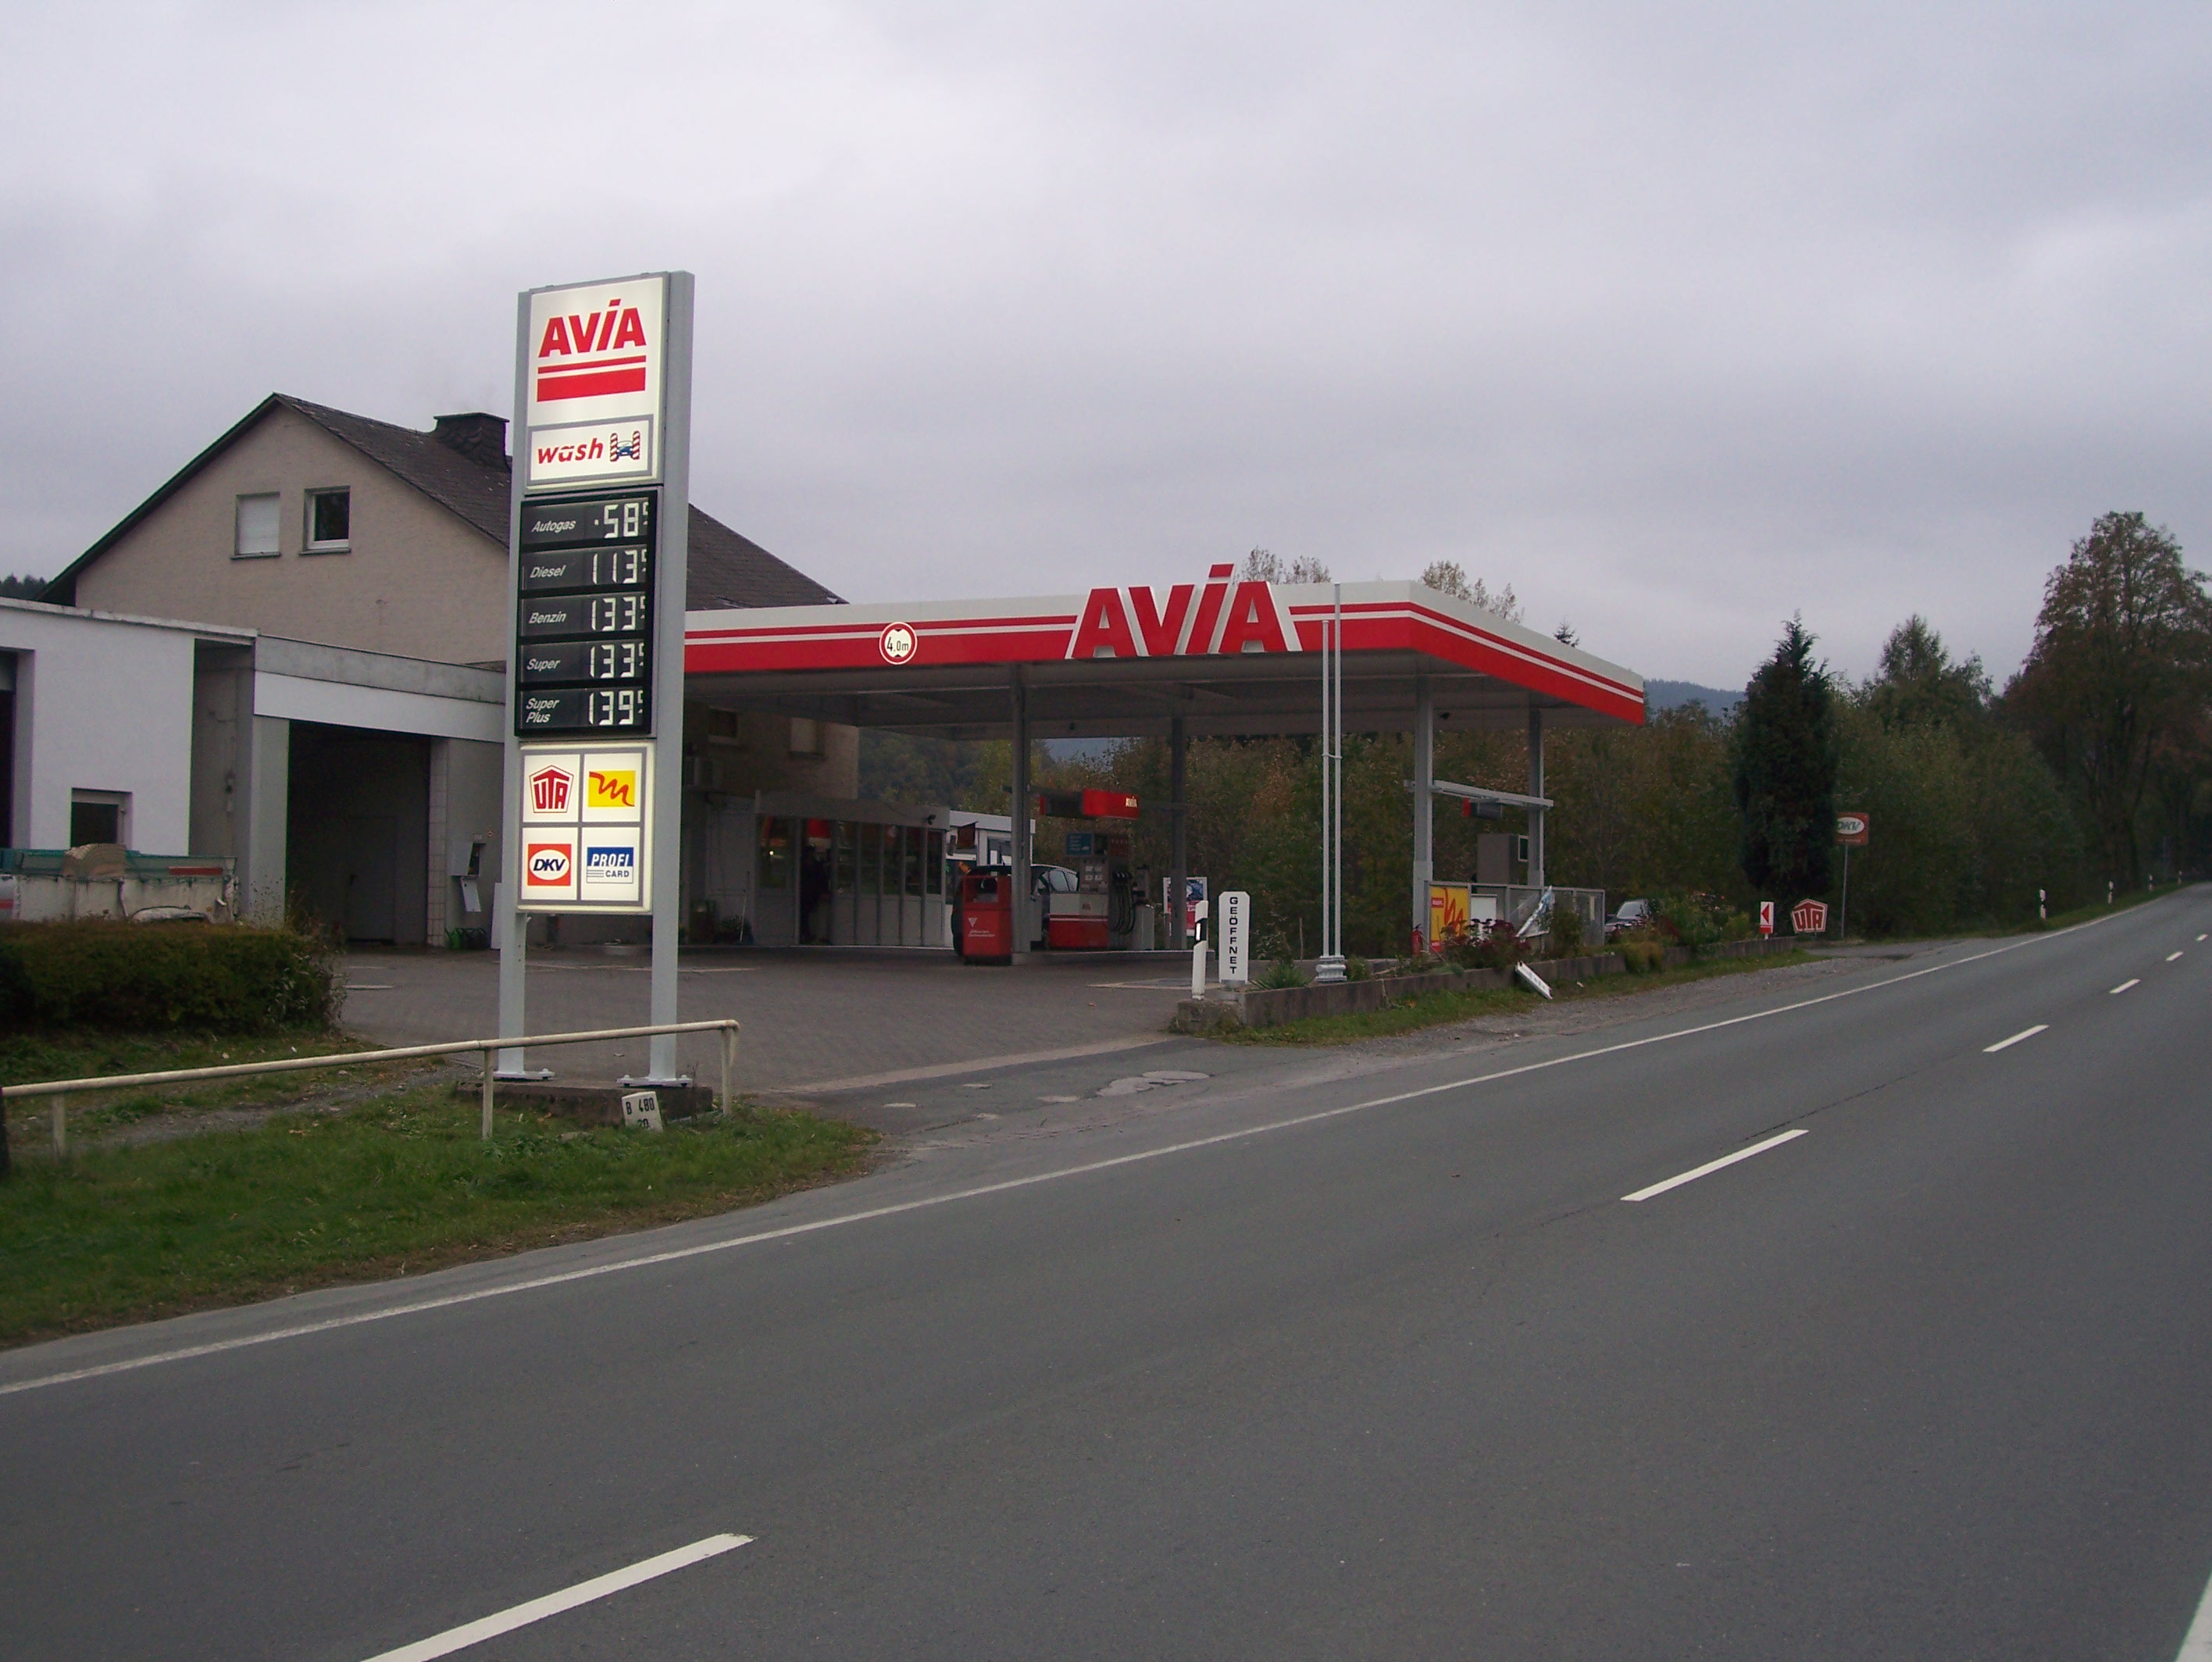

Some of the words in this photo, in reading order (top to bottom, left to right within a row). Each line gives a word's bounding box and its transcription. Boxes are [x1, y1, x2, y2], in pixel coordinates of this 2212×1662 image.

[537, 437, 604, 464] wash
[531, 519, 576, 533] Autogas
[530, 564, 566, 578] Diesel
[529, 610, 567, 624] Benzin
[526, 658, 561, 672] Super
[526, 697, 560, 711] Super
[526, 711, 551, 724] Plus
[533, 858, 566, 872] DKV
[591, 853, 630, 867] PROFI
[626, 1101, 633, 1115] B
[638, 1097, 655, 1112] 480
